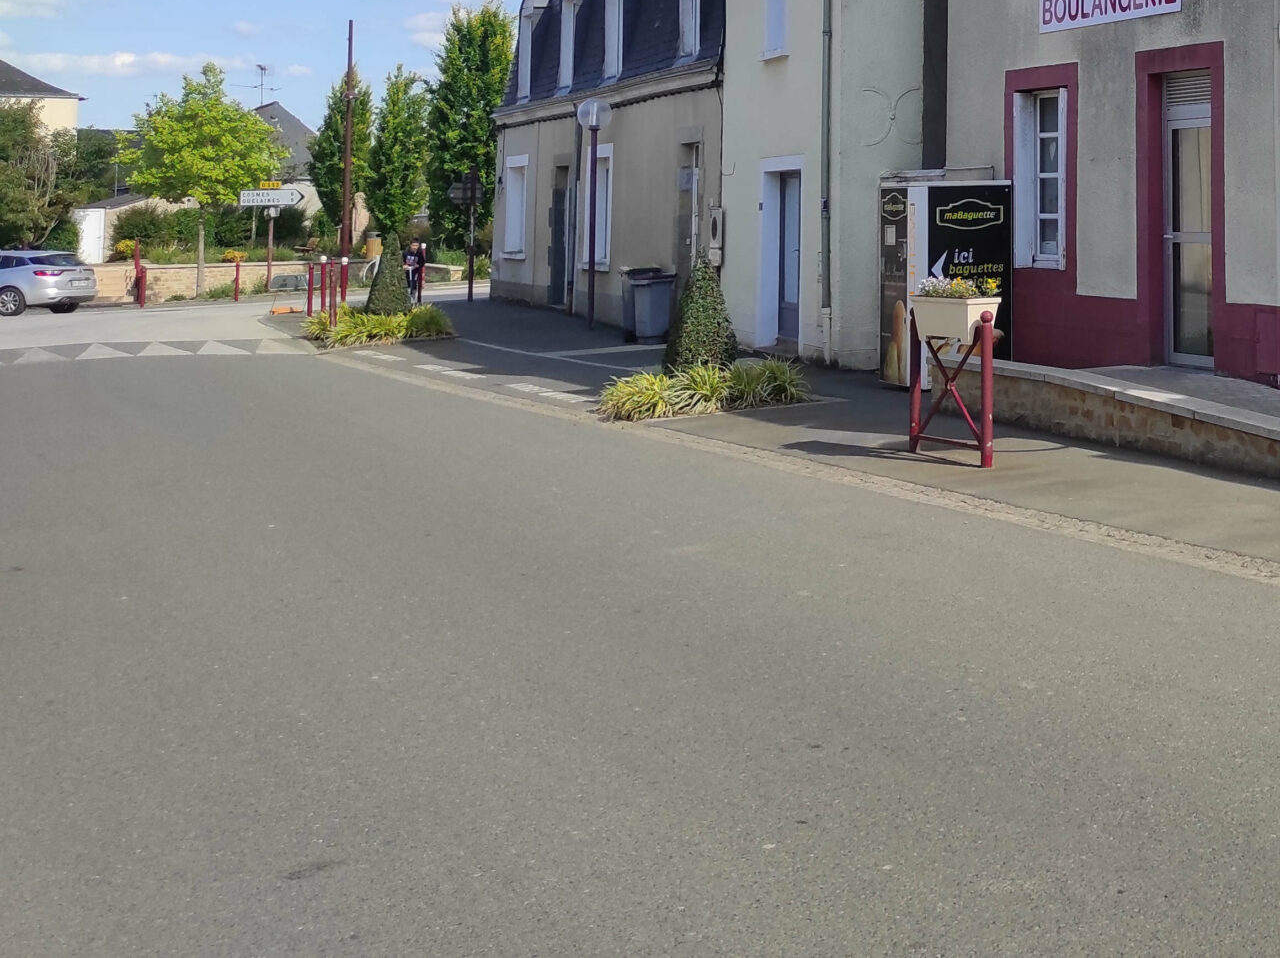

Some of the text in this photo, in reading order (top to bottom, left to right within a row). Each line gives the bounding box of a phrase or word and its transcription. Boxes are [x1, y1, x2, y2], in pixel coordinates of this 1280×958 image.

[944, 210, 997, 221] maBaguette
[953, 248, 974, 264] ici
[948, 263, 1004, 276] baguettes
